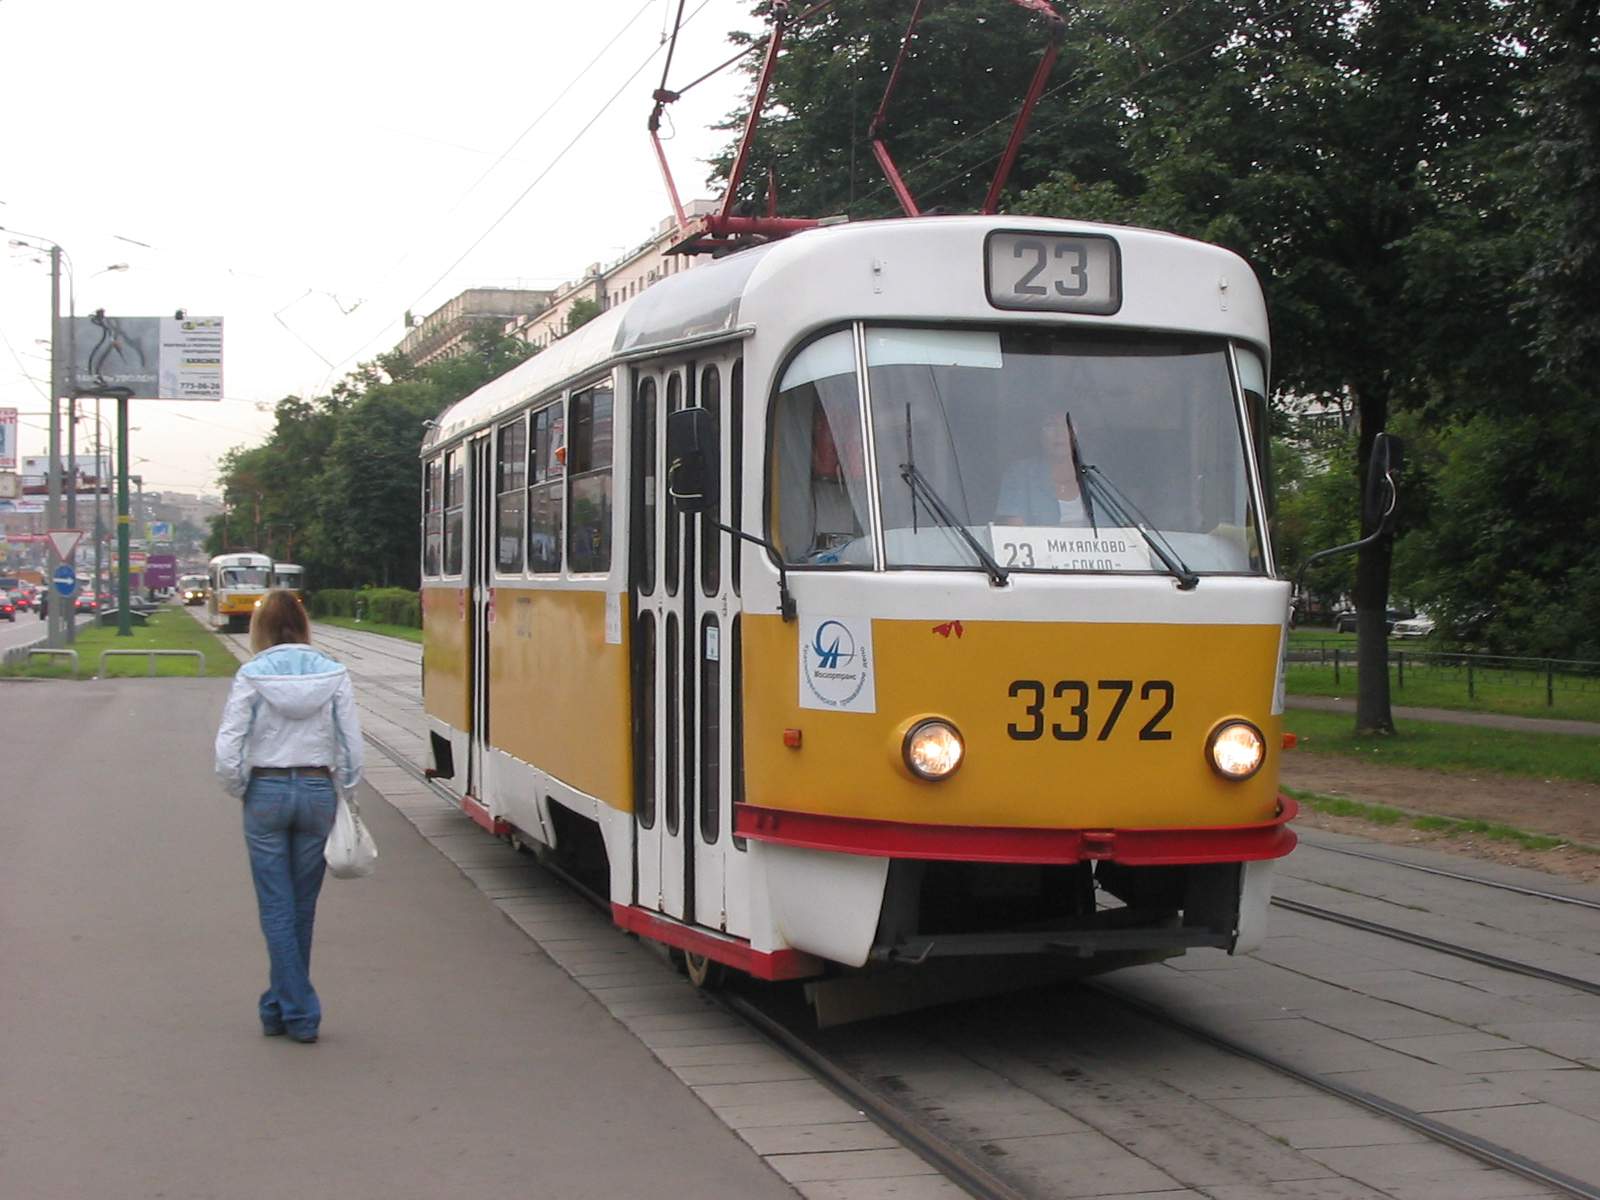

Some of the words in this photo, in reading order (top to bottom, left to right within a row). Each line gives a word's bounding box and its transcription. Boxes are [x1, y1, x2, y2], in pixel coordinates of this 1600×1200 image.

[1014, 240, 1088, 296] 23
[1003, 542, 1035, 568] 23
[1007, 680, 1175, 741] 3372
